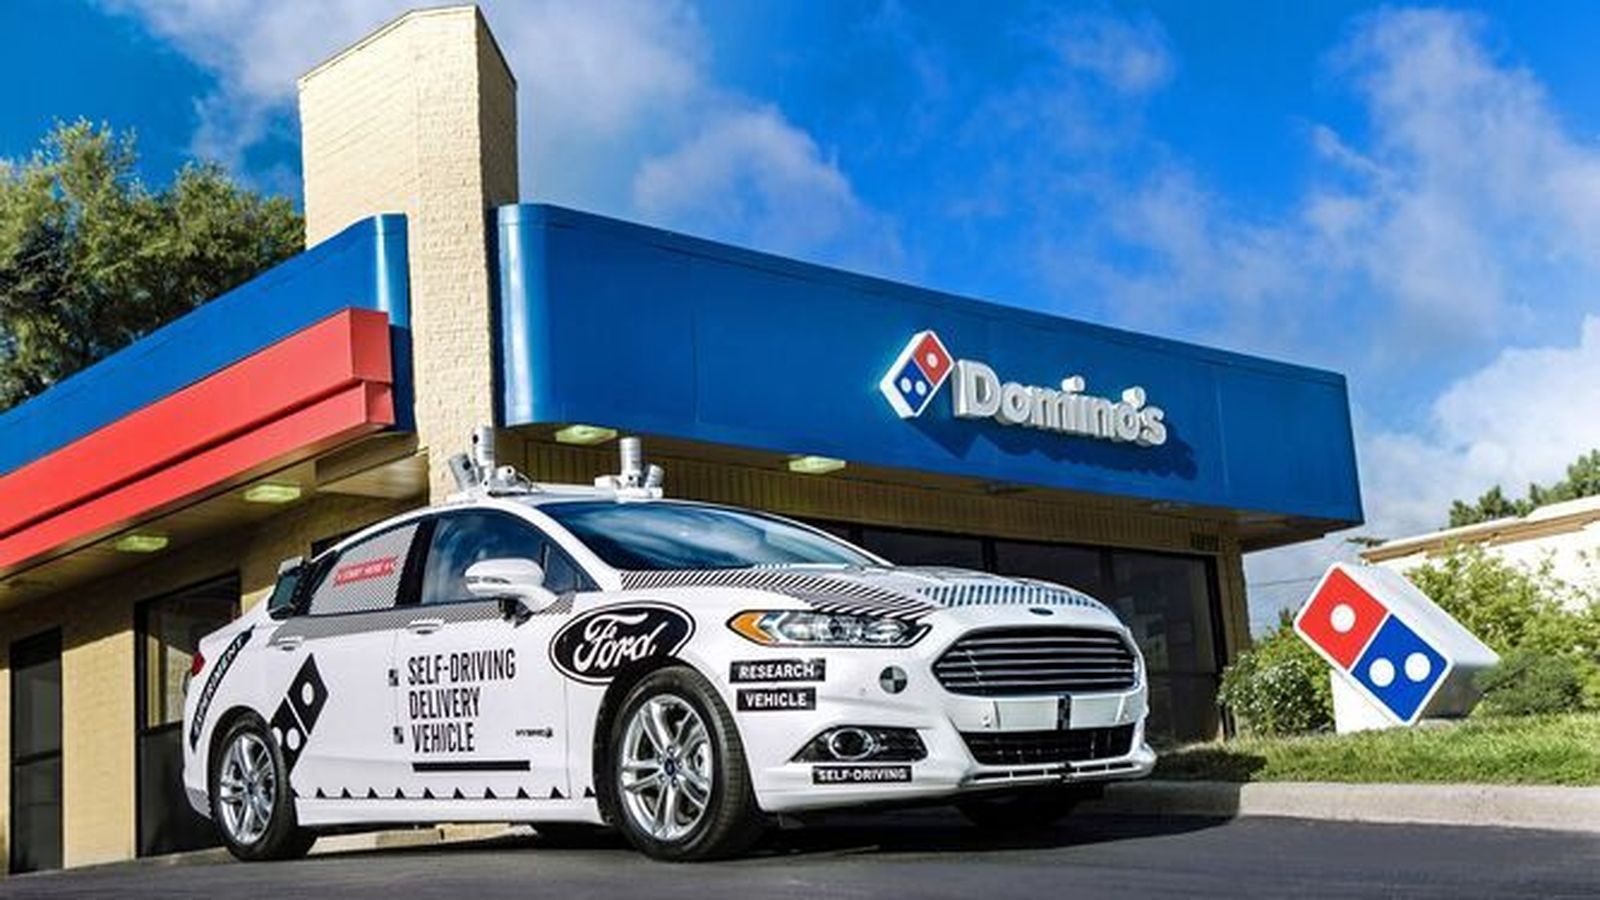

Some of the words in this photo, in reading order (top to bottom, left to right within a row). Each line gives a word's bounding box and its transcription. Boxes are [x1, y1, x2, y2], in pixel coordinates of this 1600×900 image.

[952, 359, 1167, 446] Domino's
[573, 613, 668, 672] Ford
[408, 648, 516, 685] SELF-DRIVING
[738, 663, 815, 680] RESEARCH
[409, 687, 480, 719] DELIVERY
[745, 692, 808, 708] VEHICLE
[412, 722, 475, 753] VEHICLE
[818, 768, 908, 782] SELF-DRIVING
